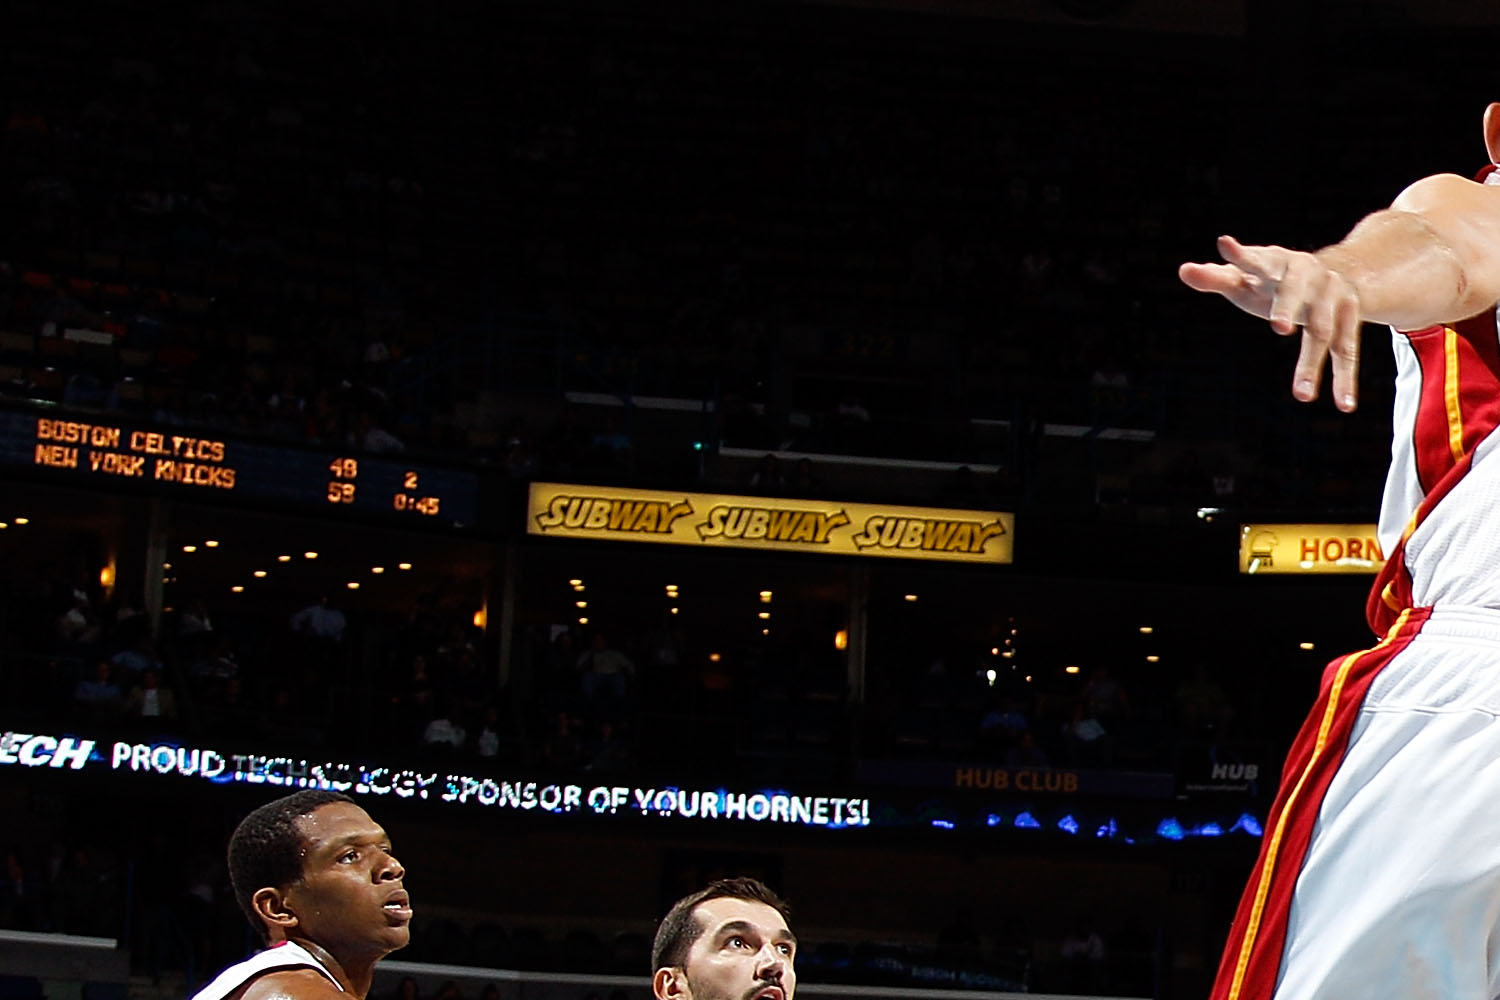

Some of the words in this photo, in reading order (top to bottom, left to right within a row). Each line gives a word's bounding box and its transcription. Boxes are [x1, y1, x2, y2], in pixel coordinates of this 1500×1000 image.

[34, 443, 78, 471] NEW
[90, 452, 144, 478] YORK
[153, 458, 237, 490] KNICKS
[36, 418, 120, 448] BOSTON
[129, 430, 225, 463] CELTICS
[402, 470, 419, 490] 2
[536, 495, 694, 534] SUBWAY
[696, 506, 850, 544] SUBWAY
[853, 515, 1006, 553] SUBWAY
[112, 741, 225, 779] PROUD
[441, 774, 582, 813] SPONSOR
[588, 786, 630, 816] OF
[634, 787, 723, 819] YOUR
[725, 792, 870, 828] HORNETS!
[955, 768, 1008, 791] HUB
[1015, 769, 1080, 794] CLUB
[1211, 763, 1259, 780] HUB
